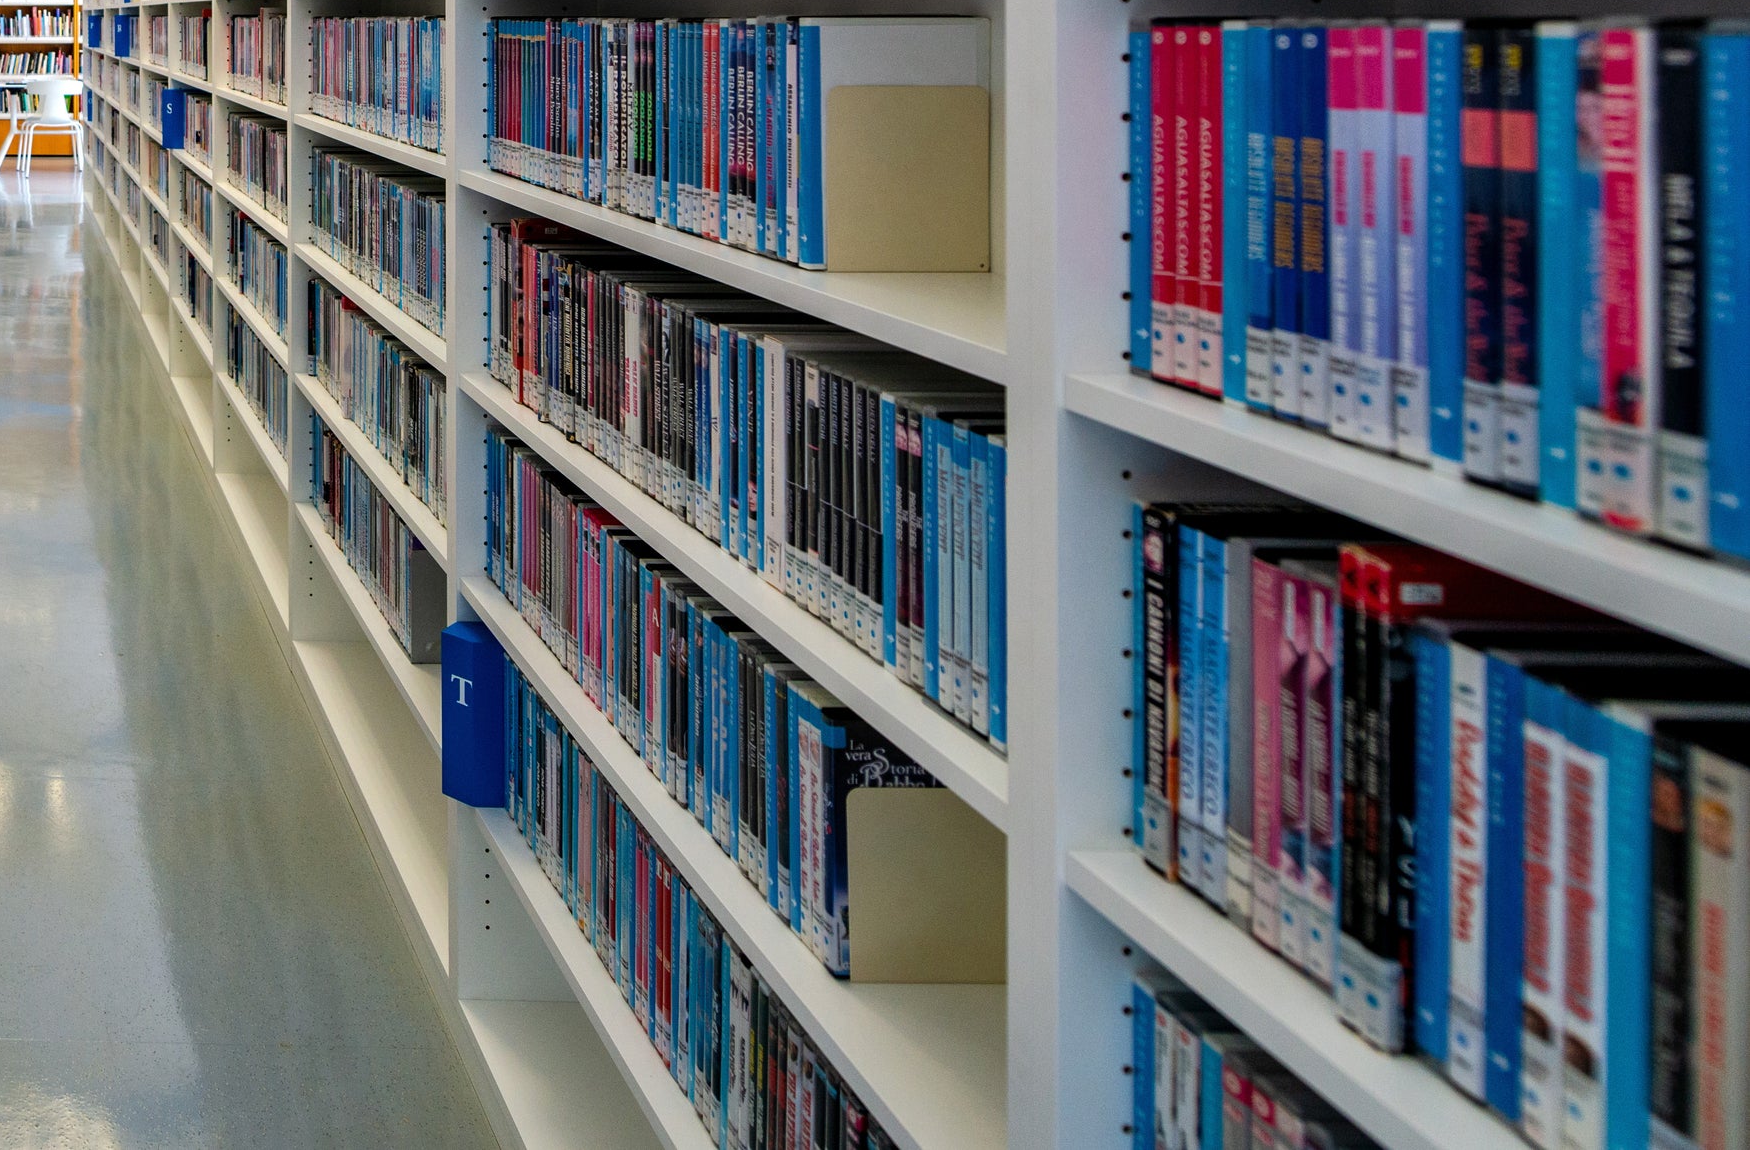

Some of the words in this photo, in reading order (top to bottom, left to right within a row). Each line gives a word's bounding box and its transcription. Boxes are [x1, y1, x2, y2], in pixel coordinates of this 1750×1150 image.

[737, 66, 745, 108] BERLIN
[166, 103, 173, 114] S
[737, 111, 745, 165] CALLING
[1146, 578, 1163, 589] I
[1146, 590, 1163, 674] CANNONI
[1204, 611, 1222, 630] IL
[450, 674, 473, 707] T
[1146, 678, 1163, 703] DI
[1204, 634, 1222, 739] MAGNATE
[845, 751, 871, 761] vera
[850, 739, 864, 750] La
[847, 773, 858, 785] di
[1204, 741, 1222, 817] GRECO
